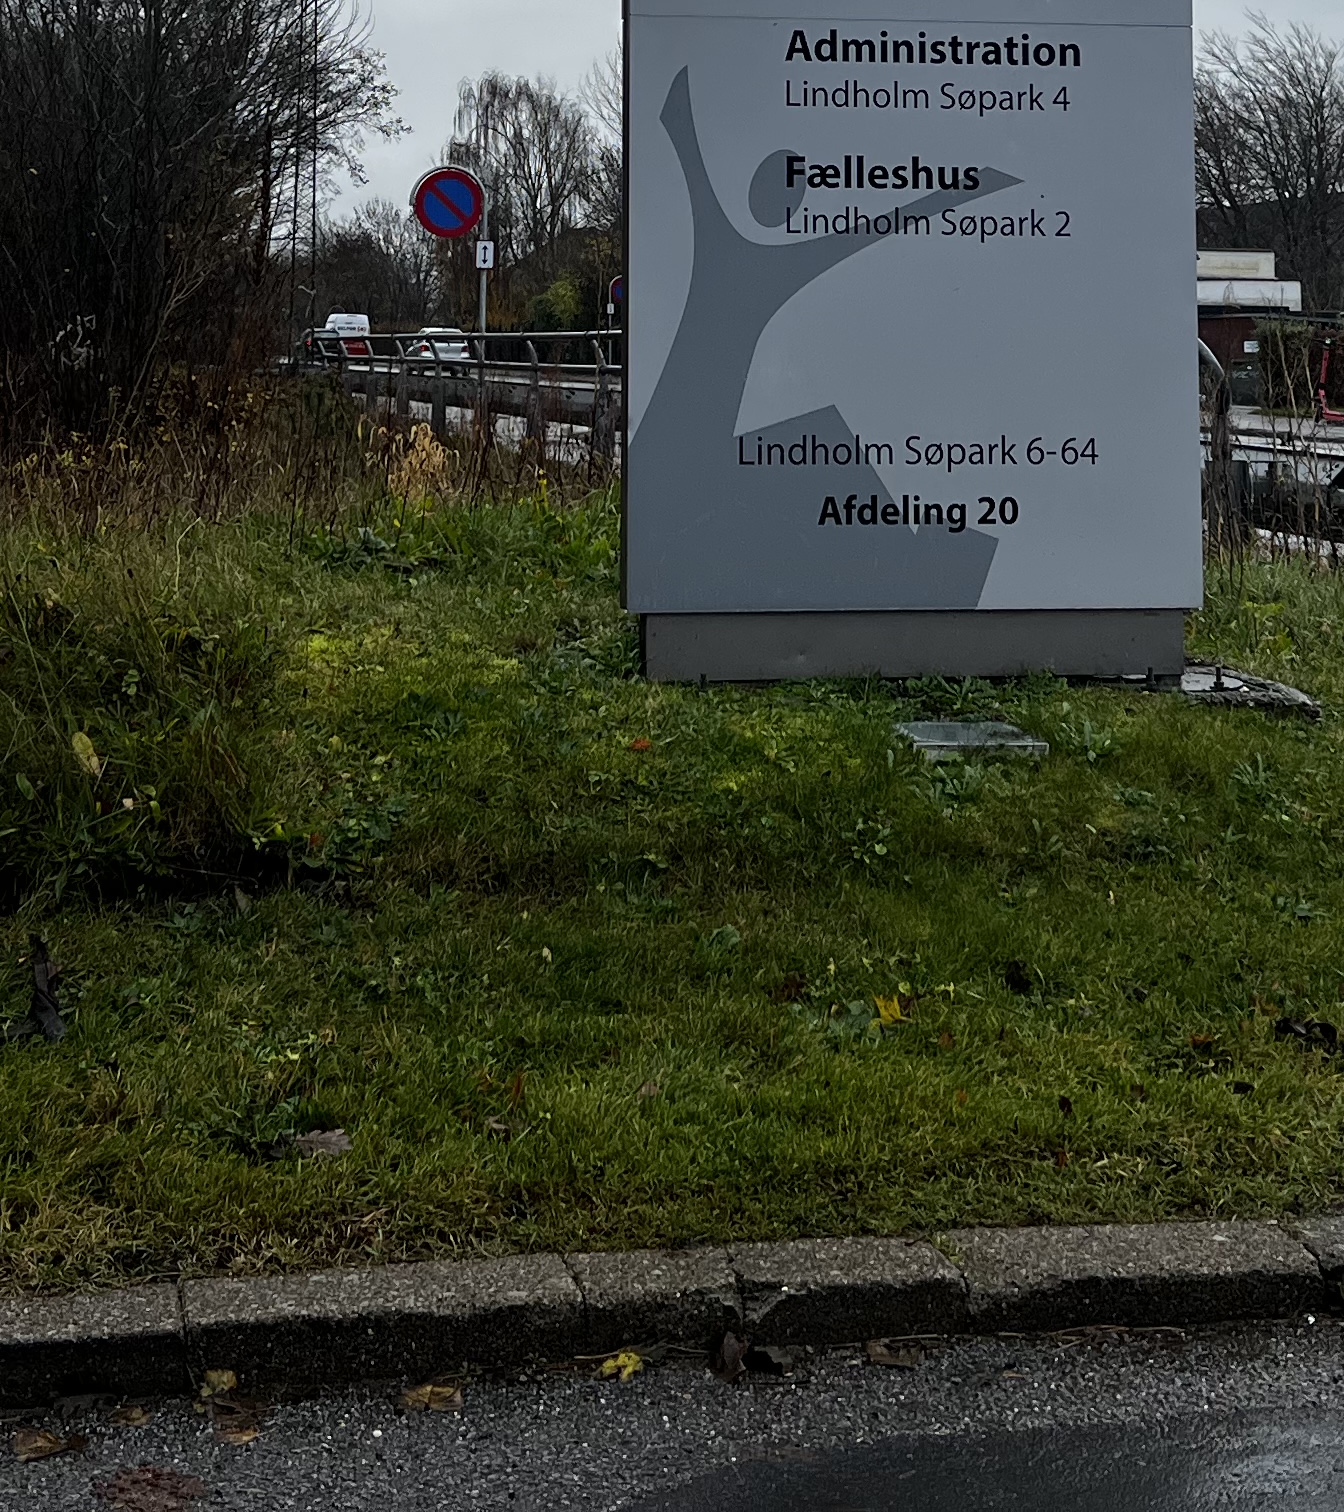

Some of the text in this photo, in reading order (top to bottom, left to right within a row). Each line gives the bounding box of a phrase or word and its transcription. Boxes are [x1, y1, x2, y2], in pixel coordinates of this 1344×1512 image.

[784, 28, 1082, 67] Administration
[785, 79, 1071, 117] Lindholm Søpark 4
[785, 155, 981, 191] Fælleshus
[785, 205, 1072, 244] Lindholm Søpark 2
[736, 433, 1099, 473] Lindholm Søpark 6-64
[817, 493, 1020, 534] Afdeling 20
